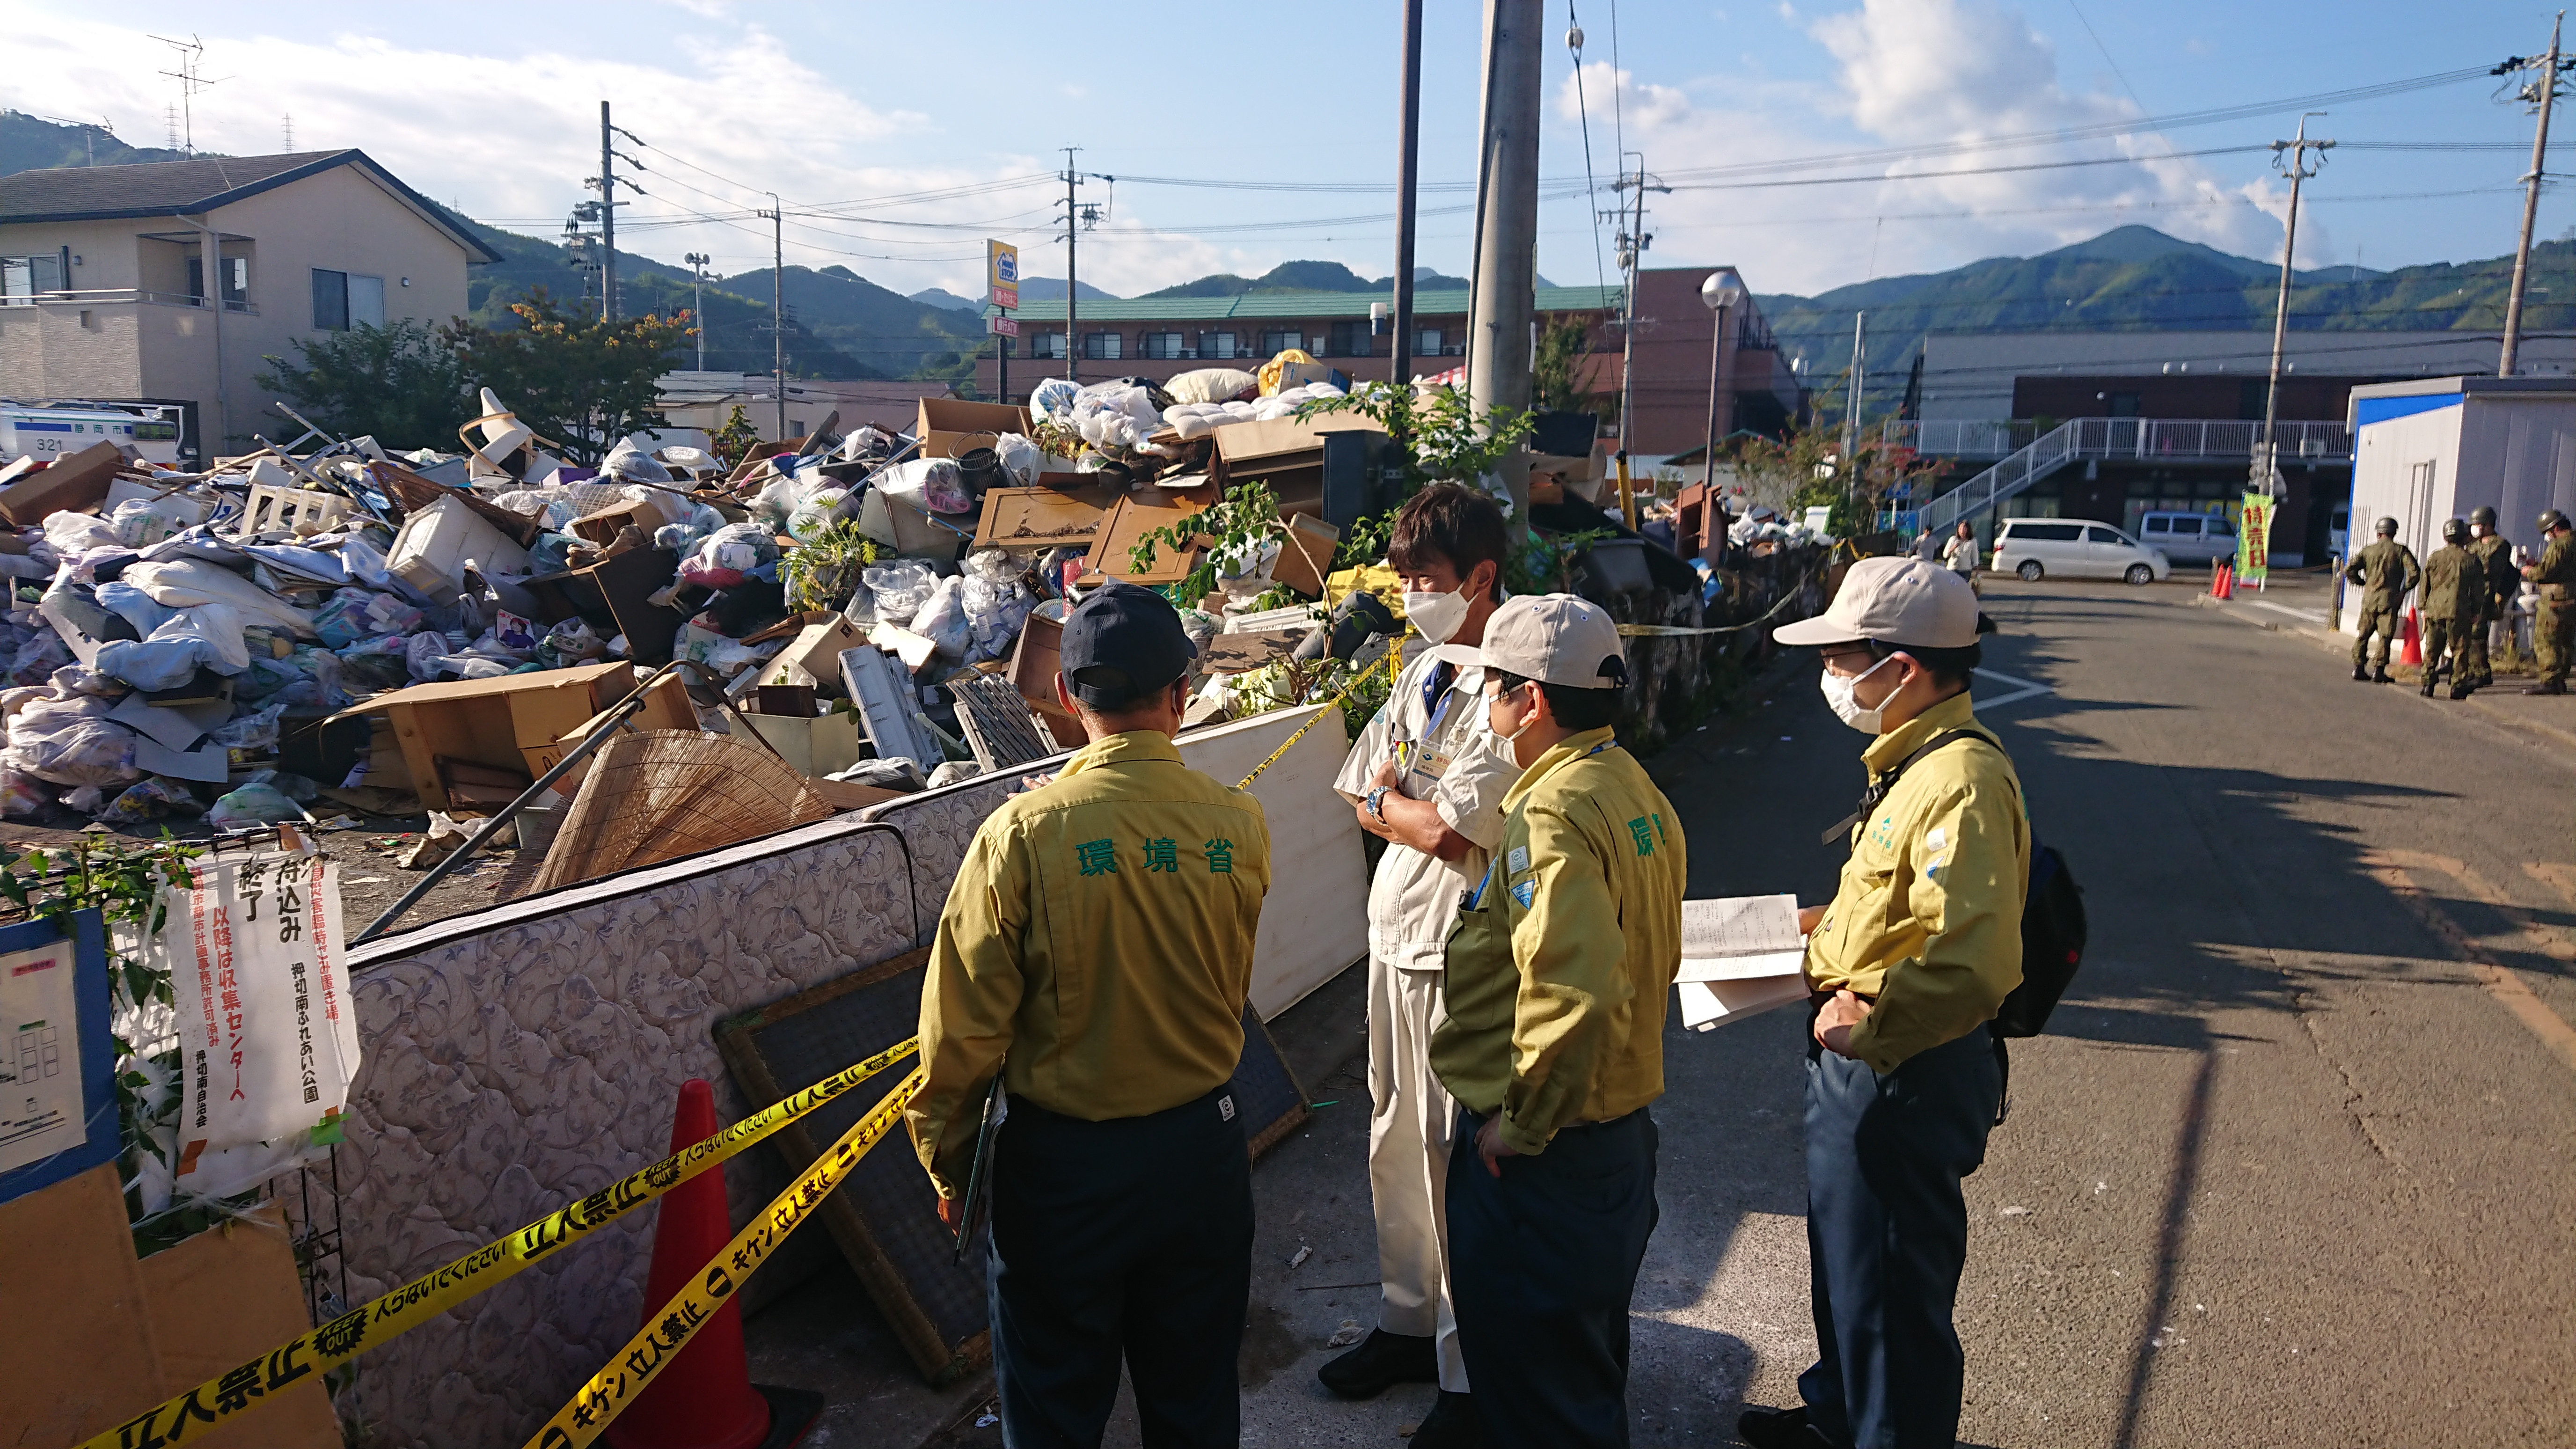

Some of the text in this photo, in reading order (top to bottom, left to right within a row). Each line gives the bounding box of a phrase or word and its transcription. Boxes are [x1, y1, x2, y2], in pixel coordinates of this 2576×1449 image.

[37, 439, 62, 451] 321
[75, 424, 122, 434] 静岡市
[1076, 837, 1234, 877] 環境省
[239, 858, 269, 922] 終了
[275, 859, 301, 943] 持込み
[212, 905, 245, 1101] 以降は収集センターへ
[290, 962, 319, 1104] 押切南ふれあい公園
[195, 1050, 207, 1128] 押切南自治会
[871, 1059, 887, 1070] OUT
[649, 1155, 676, 1176] KEEP
[685, 1107, 772, 1166] 入らないでください
[653, 1167, 671, 1185] OUT
[523, 1174, 648, 1260] 立入禁止
[374, 1240, 506, 1323] 入らないでください
[322, 1312, 361, 1337] KEEP
[326, 1329, 352, 1351] OUT
[116, 1339, 312, 1449] 立入禁止
